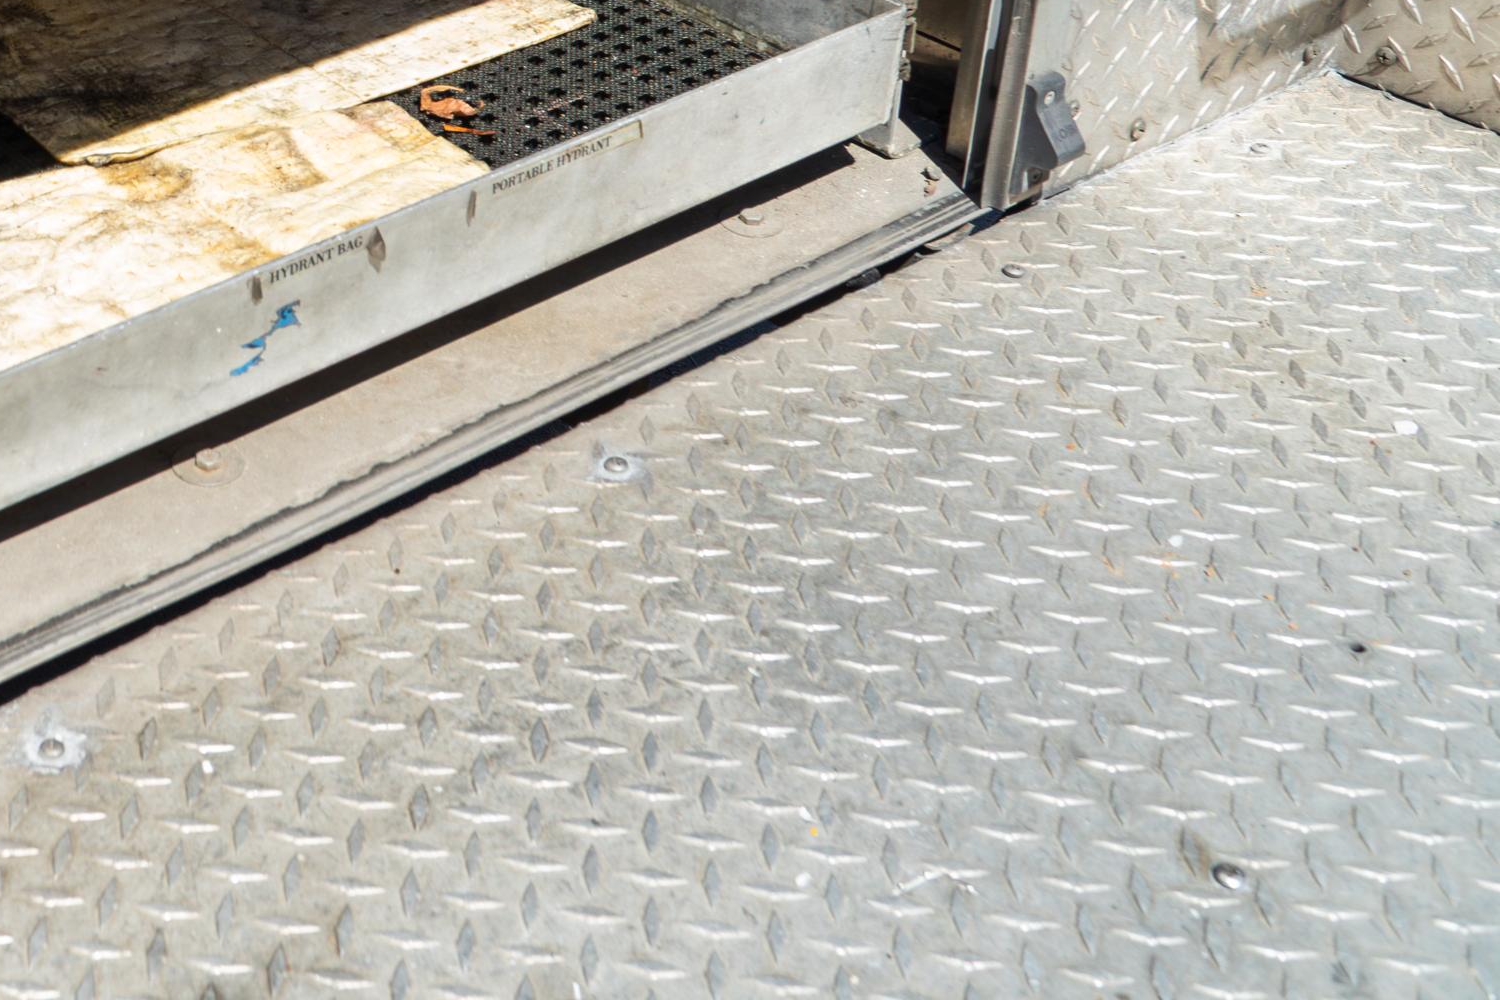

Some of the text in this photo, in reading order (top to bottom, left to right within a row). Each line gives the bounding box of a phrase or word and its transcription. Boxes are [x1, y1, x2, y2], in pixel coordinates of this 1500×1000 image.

[492, 136, 612, 194] PORTABLE HYDRANT
[269, 235, 363, 284] HYDRANT BAG
